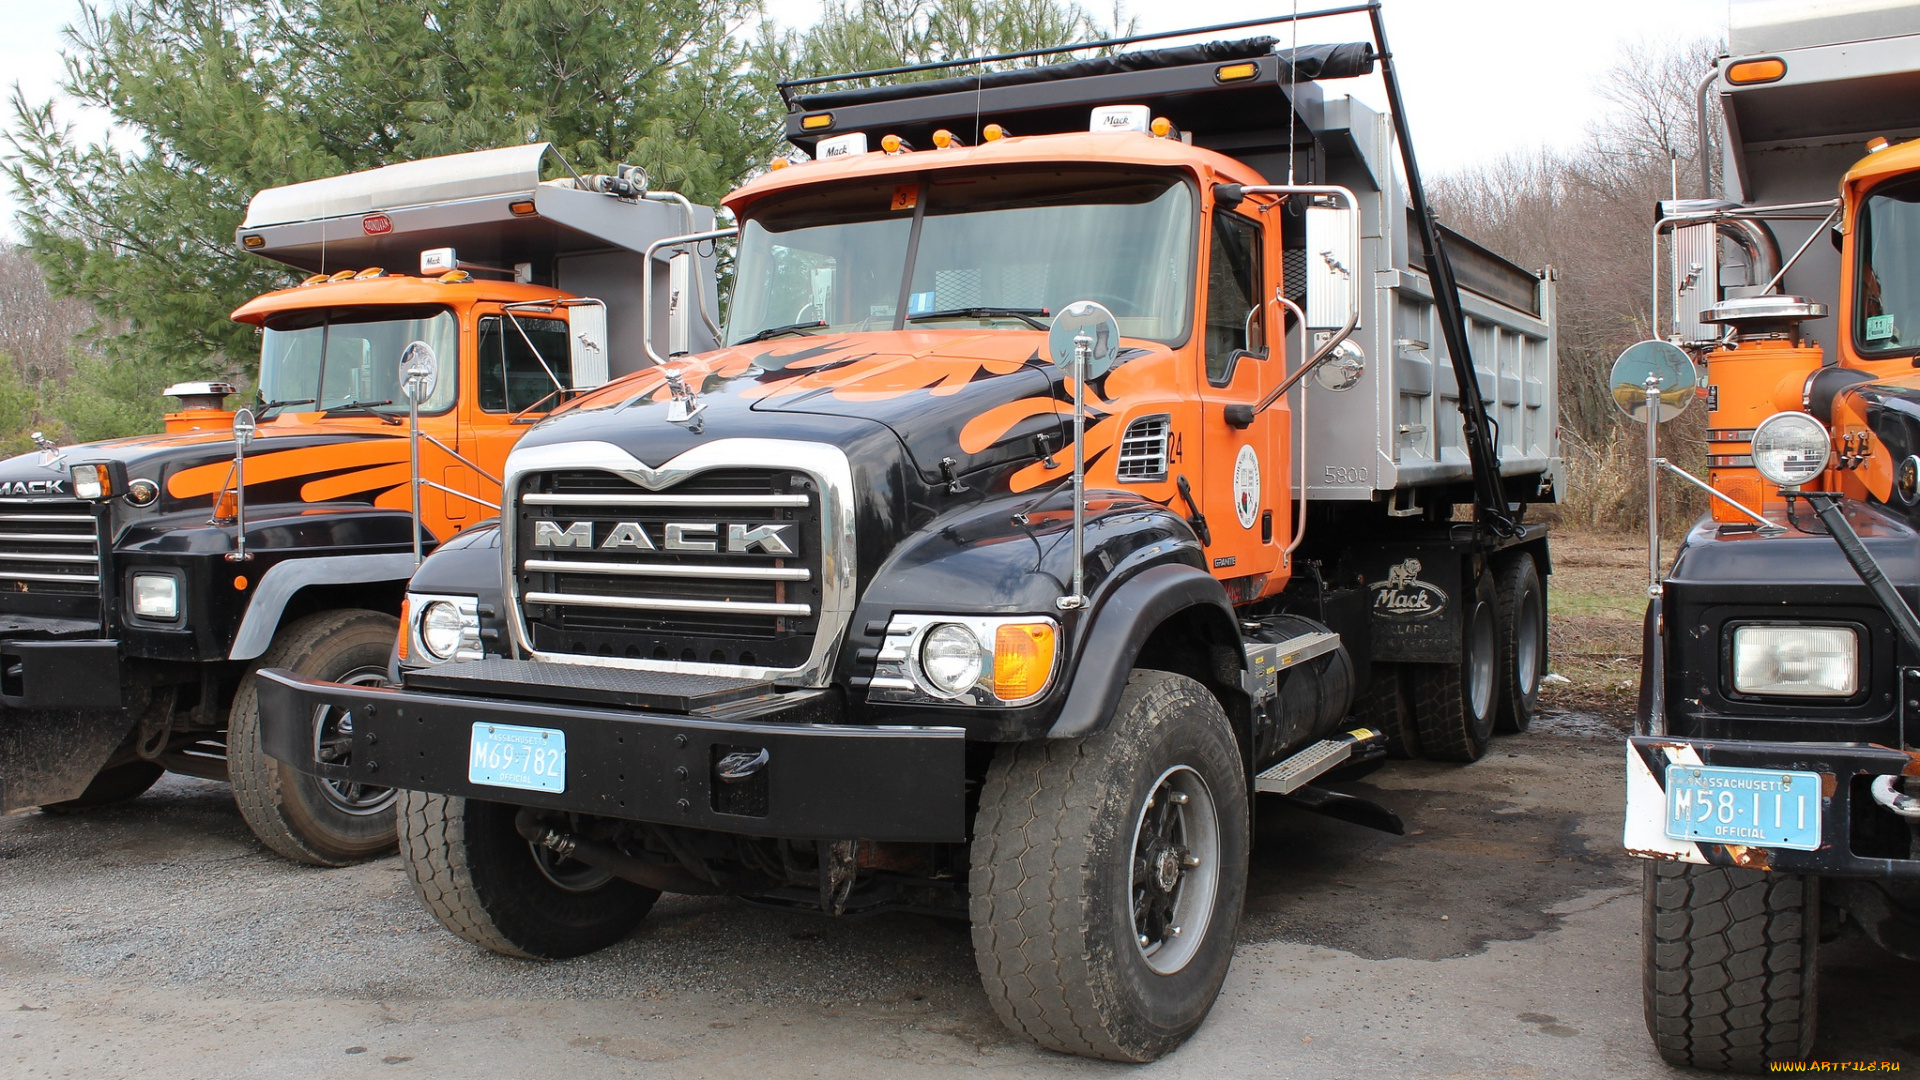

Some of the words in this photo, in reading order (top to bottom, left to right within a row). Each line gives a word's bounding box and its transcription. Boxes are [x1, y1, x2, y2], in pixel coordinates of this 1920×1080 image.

[1103, 115, 1129, 125] Mack
[826, 145, 848, 158] Mack
[1168, 431, 1182, 464] 24
[1325, 465, 1368, 484] 5800
[535, 521, 793, 554] MACK
[1214, 556, 1236, 567] GRANITE
[1373, 589, 1432, 608] Mack
[488, 732, 548, 746] MASSACHUSETTS
[499, 772, 532, 784] OFFICIAL
[1715, 825, 1766, 840] OFFICIAL
